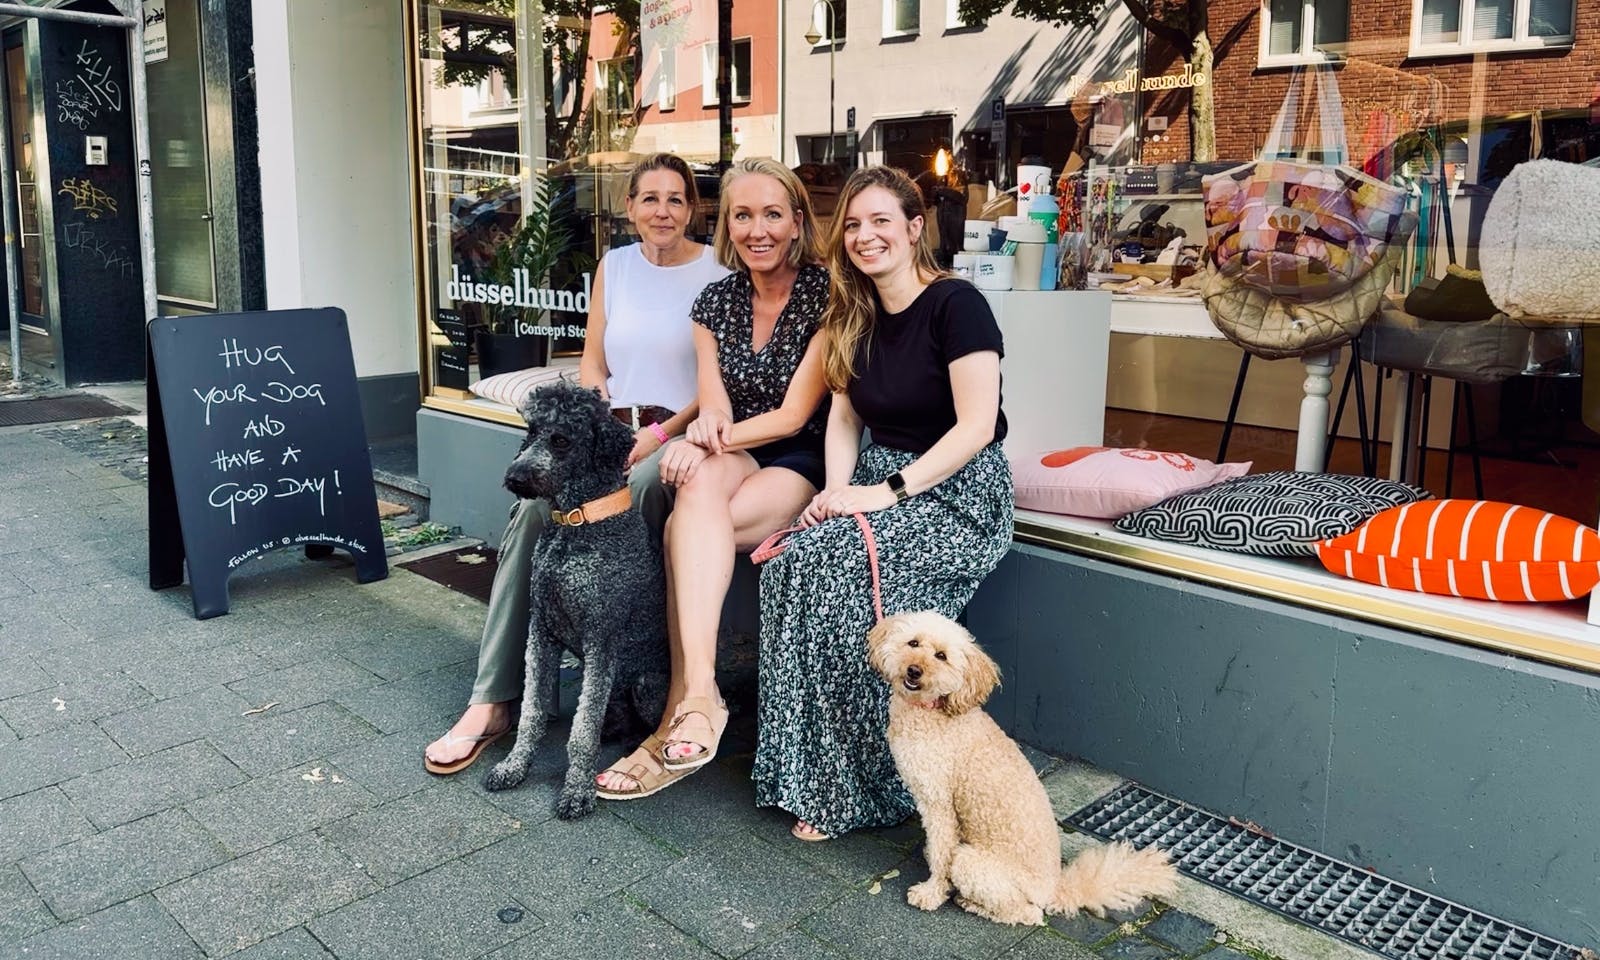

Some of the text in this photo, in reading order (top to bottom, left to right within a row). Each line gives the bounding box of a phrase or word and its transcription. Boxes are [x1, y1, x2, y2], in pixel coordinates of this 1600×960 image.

[446, 264, 591, 314] düsselhund
[218, 338, 295, 375] HUG
[193, 381, 327, 426] YOUR DOG
[243, 414, 286, 439] AND
[210, 446, 302, 472] HAVE A
[208, 478, 269, 525] GOOD
